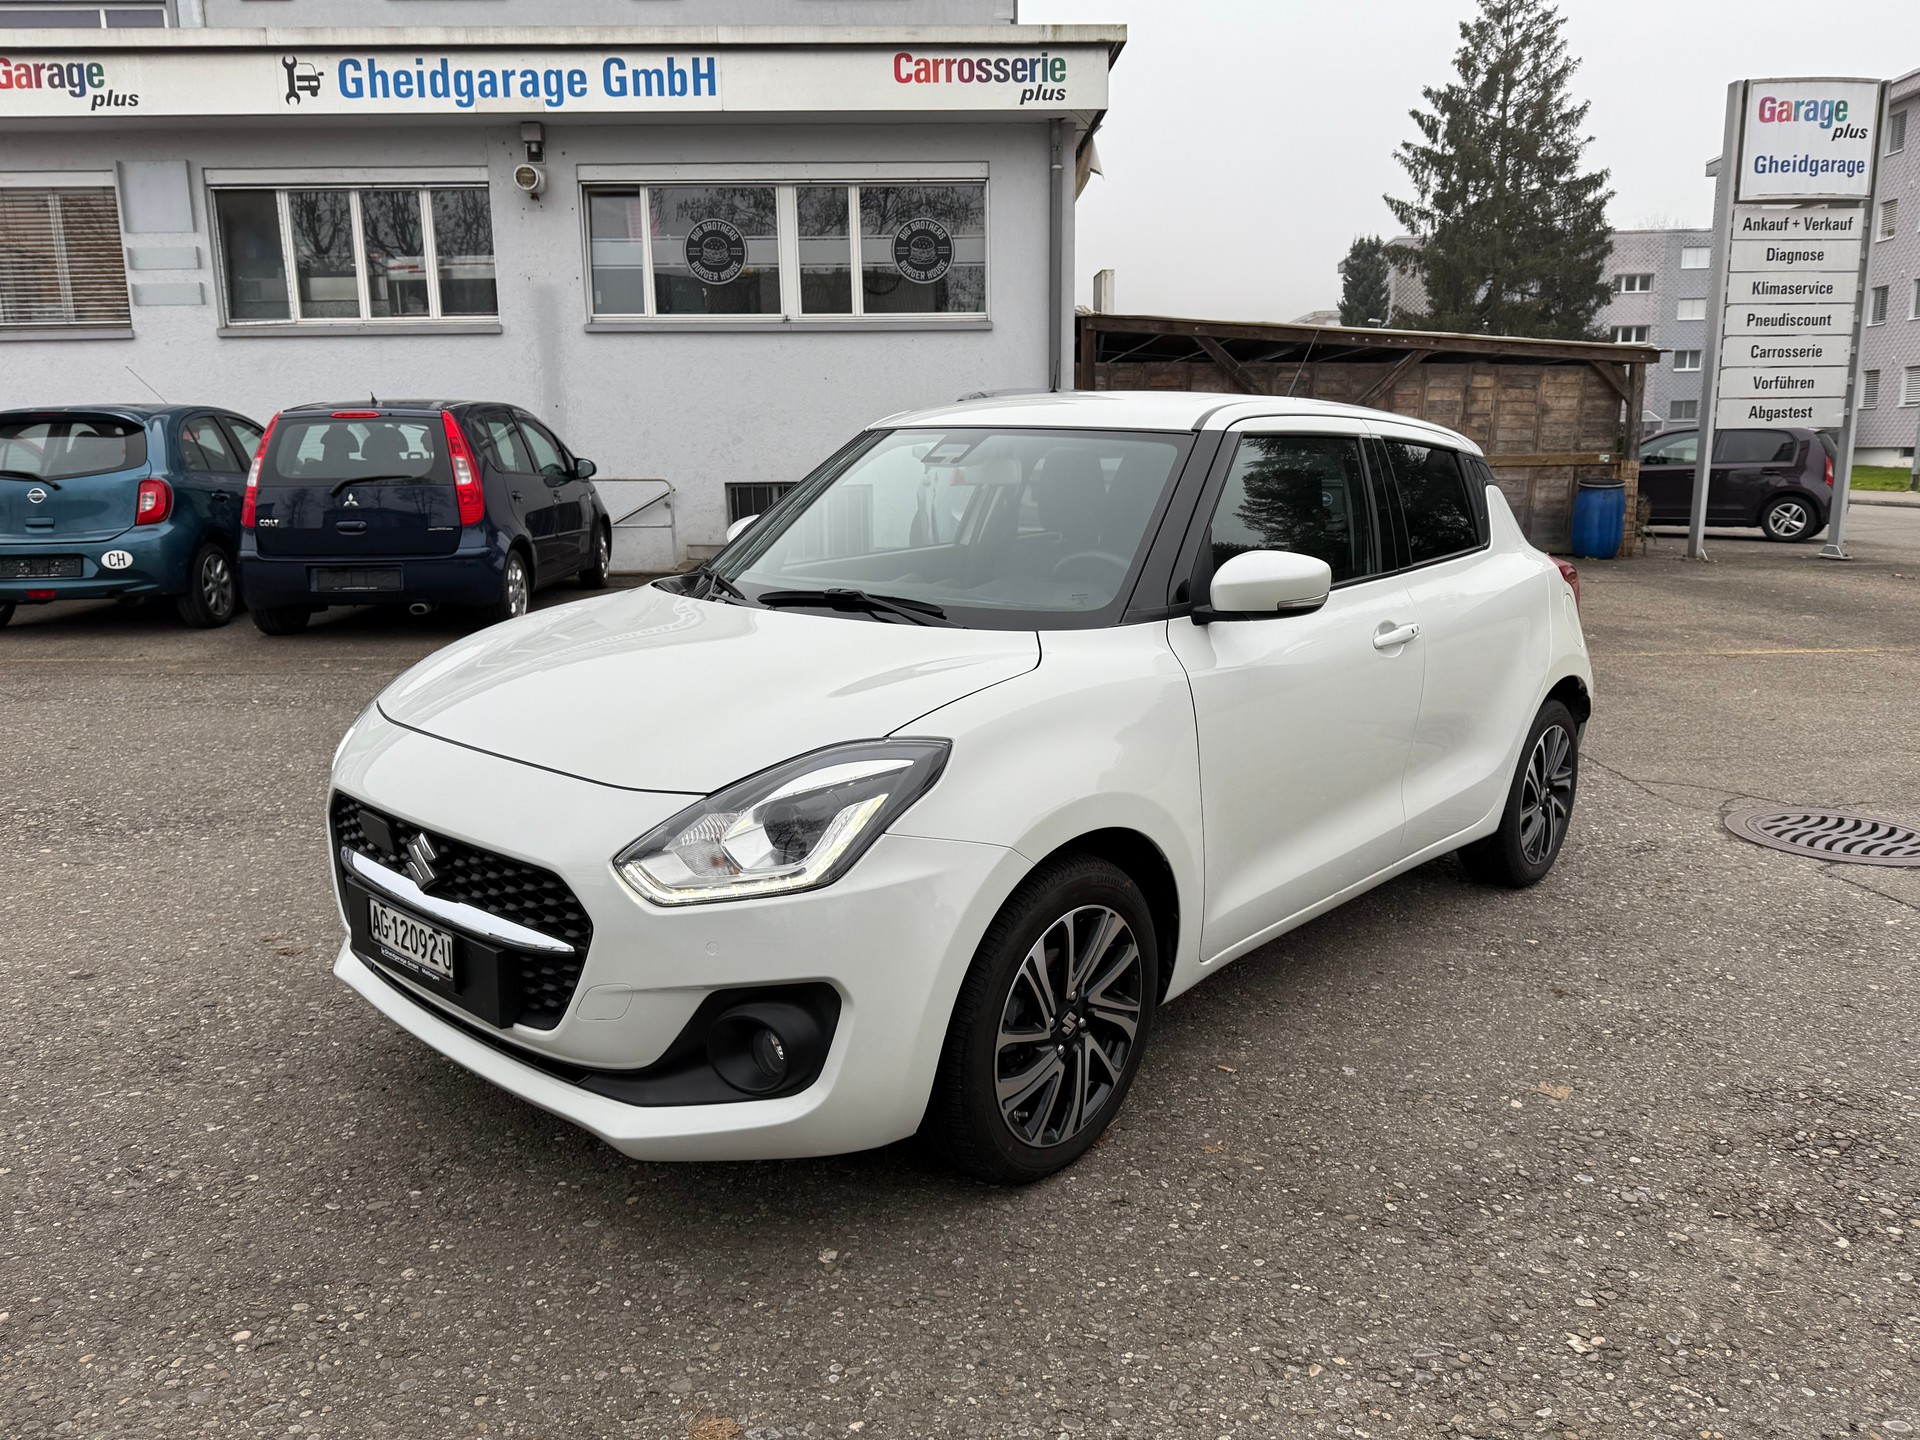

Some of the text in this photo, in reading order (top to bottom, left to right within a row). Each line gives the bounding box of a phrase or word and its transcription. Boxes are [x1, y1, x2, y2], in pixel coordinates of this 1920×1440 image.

[0, 56, 105, 98] Garage
[893, 51, 1067, 83] Carrosserie
[337, 56, 717, 108] Gheidgarage GmbH
[90, 89, 139, 111] plus
[1019, 84, 1067, 105] plus
[1758, 96, 1849, 129] Garage
[1831, 123, 1868, 141] plus
[1753, 154, 1866, 178] Gheidgarage
[690, 221, 739, 241] BIG BROTHERS
[899, 220, 947, 241] BIG BROTHERS
[1742, 217, 1790, 231] Ankauf
[1804, 216, 1854, 231] Verkauf
[1766, 247, 1825, 264] Diagnose
[691, 260, 741, 281] BURGER HOUSE
[899, 259, 948, 280] BURGER HOUSE
[1751, 281, 1834, 295] Klimaservice
[1746, 312, 1832, 327] Pneudiscount
[1750, 344, 1823, 358] Carrosserie
[1753, 376, 1815, 389] Vorführen
[1748, 405, 1813, 421] Abgastest
[259, 519, 279, 527] COLT
[108, 553, 126, 566] CH
